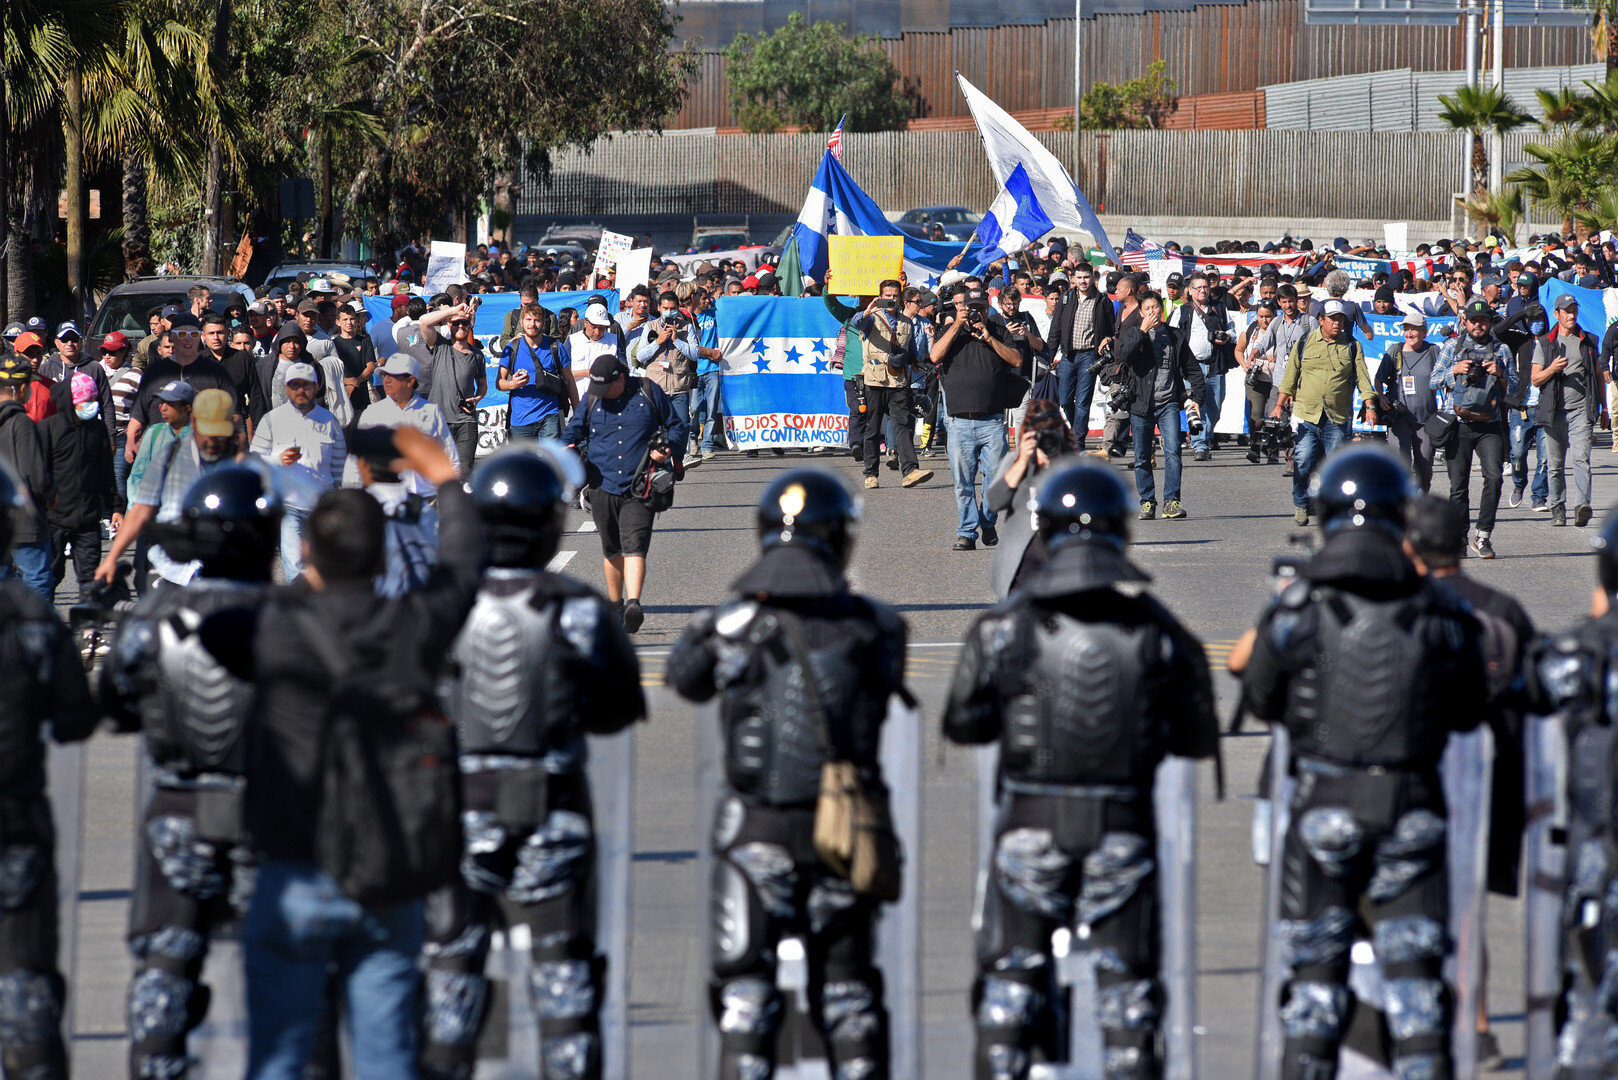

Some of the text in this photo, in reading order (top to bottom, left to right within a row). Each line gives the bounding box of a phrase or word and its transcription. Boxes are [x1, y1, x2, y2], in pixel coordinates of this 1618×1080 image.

[832, 240, 843, 249] NO
[838, 252, 850, 262] NO
[783, 413, 816, 430] CON
[760, 426, 810, 443] CONTRA
[810, 428, 850, 444] NOSOT
